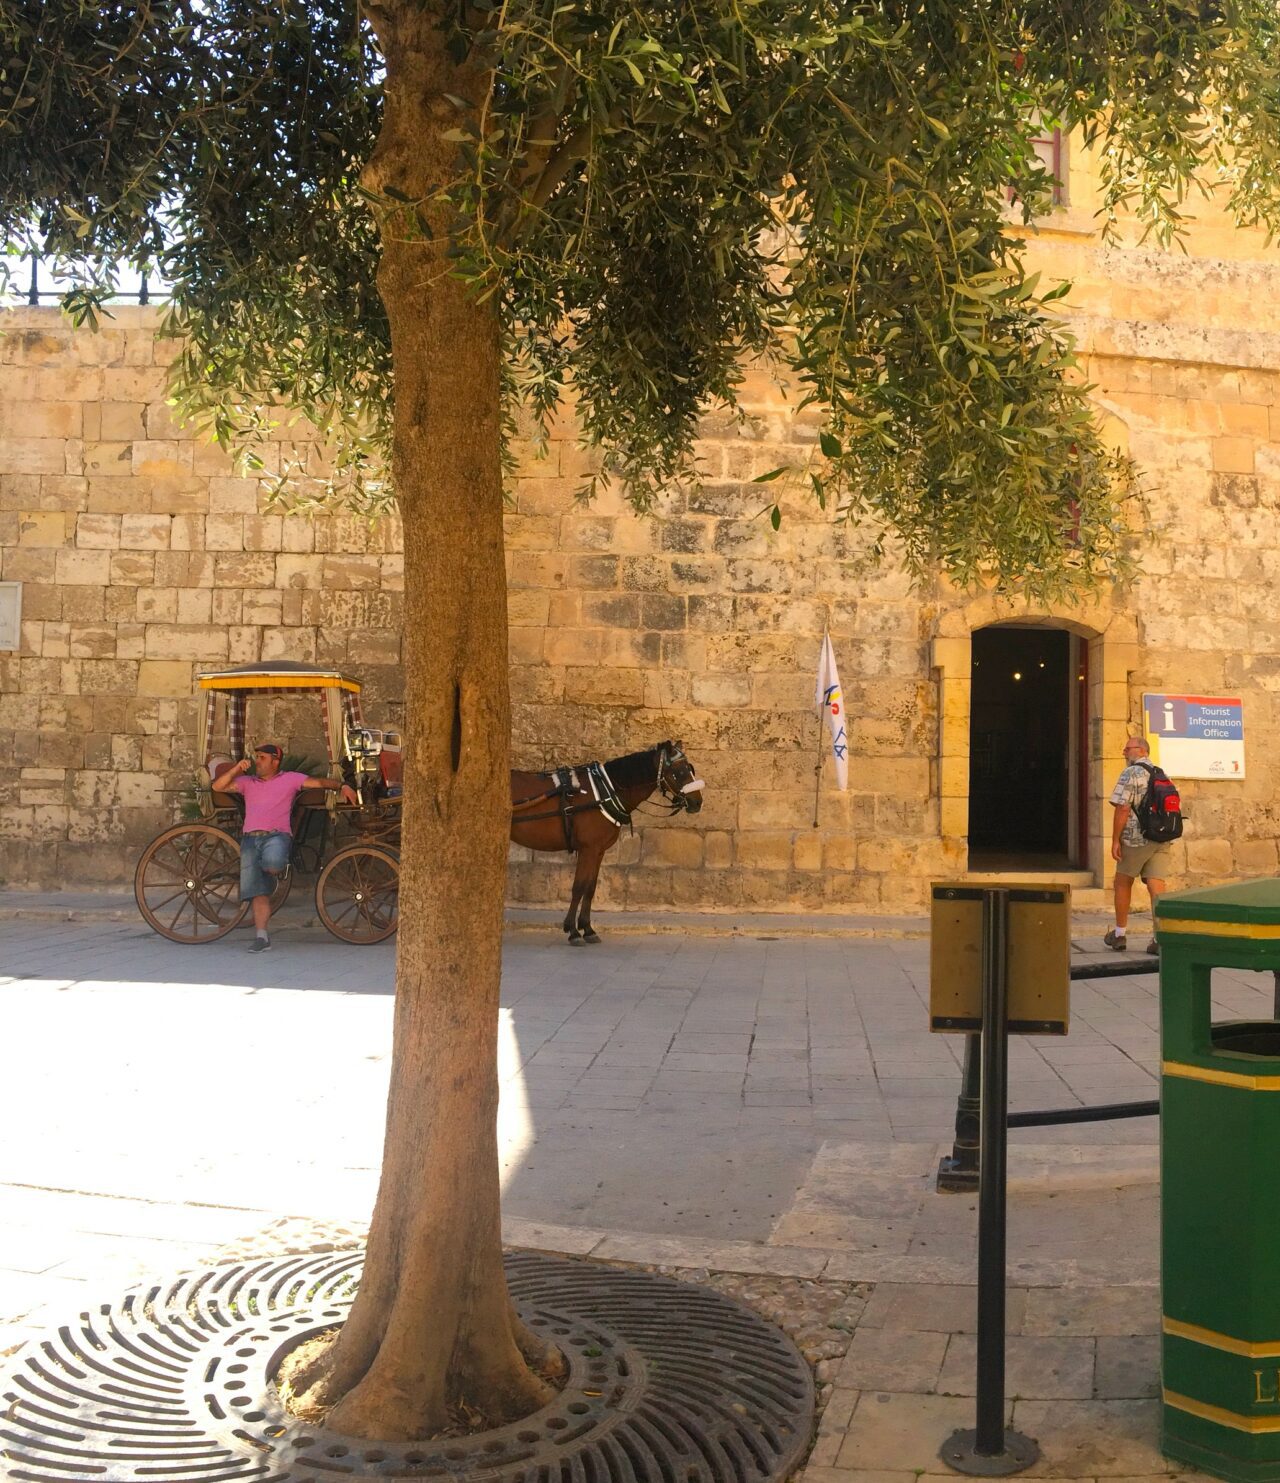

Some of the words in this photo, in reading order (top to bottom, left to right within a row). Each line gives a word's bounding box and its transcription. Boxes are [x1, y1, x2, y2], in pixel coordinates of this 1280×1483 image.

[1162, 702, 1177, 731] i
[1200, 707, 1231, 716] Tourist
[1189, 716, 1242, 727] Information
[1203, 728, 1230, 738] Office
